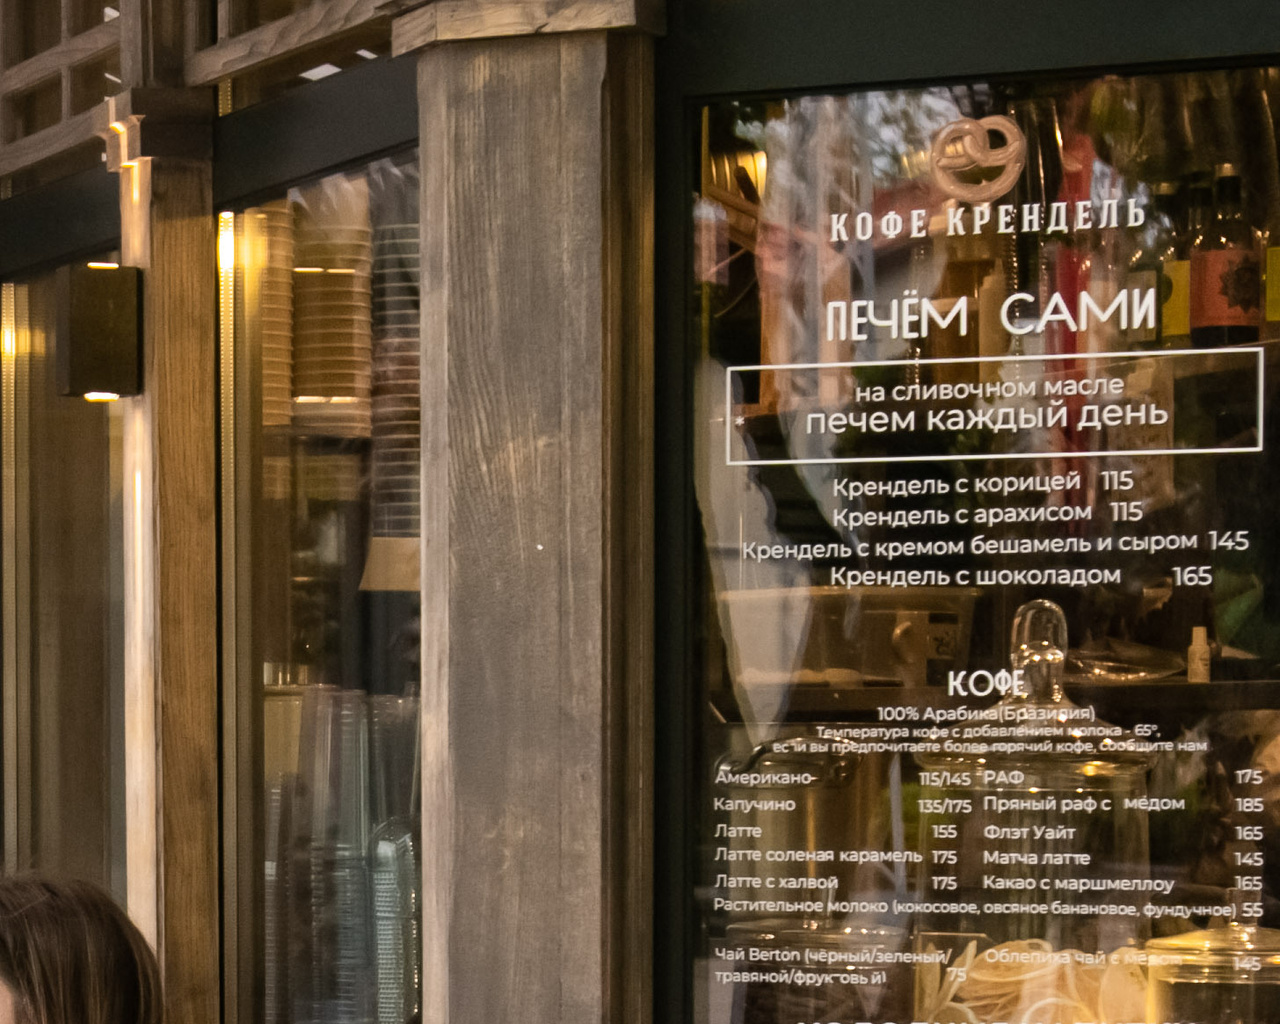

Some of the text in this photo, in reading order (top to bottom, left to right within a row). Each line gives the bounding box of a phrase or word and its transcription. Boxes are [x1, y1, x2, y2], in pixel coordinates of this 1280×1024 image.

[830, 197, 1146, 242] КОФЕ КРЕНДЕЛЬ
[827, 288, 1156, 341] ПЕЧЁМ САМИ
[856, 376, 1124, 402] на сливочном масле
[807, 400, 1168, 434] печем каждый день
[834, 470, 1133, 500] Крендель с корицей 115
[834, 502, 1143, 529] Крендель с арахисом 115
[742, 530, 1249, 563] Крендель с кремом бешамель и сыром 145
[831, 564, 1213, 588] Крендель с шоколадом 165
[948, 669, 1025, 697] КОФЕ
[877, 707, 920, 721] 100%
[817, 726, 910, 740] Температура
[913, 727, 949, 741] кофе
[963, 725, 1064, 738] добавлением
[1067, 727, 1122, 737] молока
[810, 742, 828, 752] вы
[832, 742, 940, 755] предпочитаете
[944, 740, 988, 753] более
[991, 740, 1053, 754] горячий
[1056, 740, 1097, 754] кофе,
[1099, 738, 1174, 753] сообщите
[1178, 741, 1208, 751] нам
[714, 771, 972, 787] Американо 115/145
[983, 769, 1263, 785] РАФ 175
[714, 798, 972, 814] Капучино 135/175
[983, 795, 1056, 813] Пряный
[1060, 796, 1098, 814] раф
[1235, 798, 1264, 813] 185
[714, 824, 957, 839] Латте 155
[984, 824, 1264, 840] Флэт Уайт 165
[714, 848, 957, 864] Латте соленая карамель 175
[983, 851, 1264, 866] Матча латте 145
[714, 875, 762, 889] Латте
[778, 876, 838, 889] халвой
[932, 876, 957, 890] 175
[983, 875, 1037, 889] Какао
[1055, 878, 1175, 894] маршмеллоу
[1234, 876, 1263, 890] 165
[714, 898, 1264, 919] Растительное молоко (кокосовое, овсяное банановое, фундучное) 55
[714, 948, 746, 961] Чай
[748, 948, 801, 961] Berton
[985, 949, 1070, 964] Облепиха
[1074, 950, 1106, 965] чай
[1233, 957, 1261, 971] 145
[947, 968, 967, 982] 75
